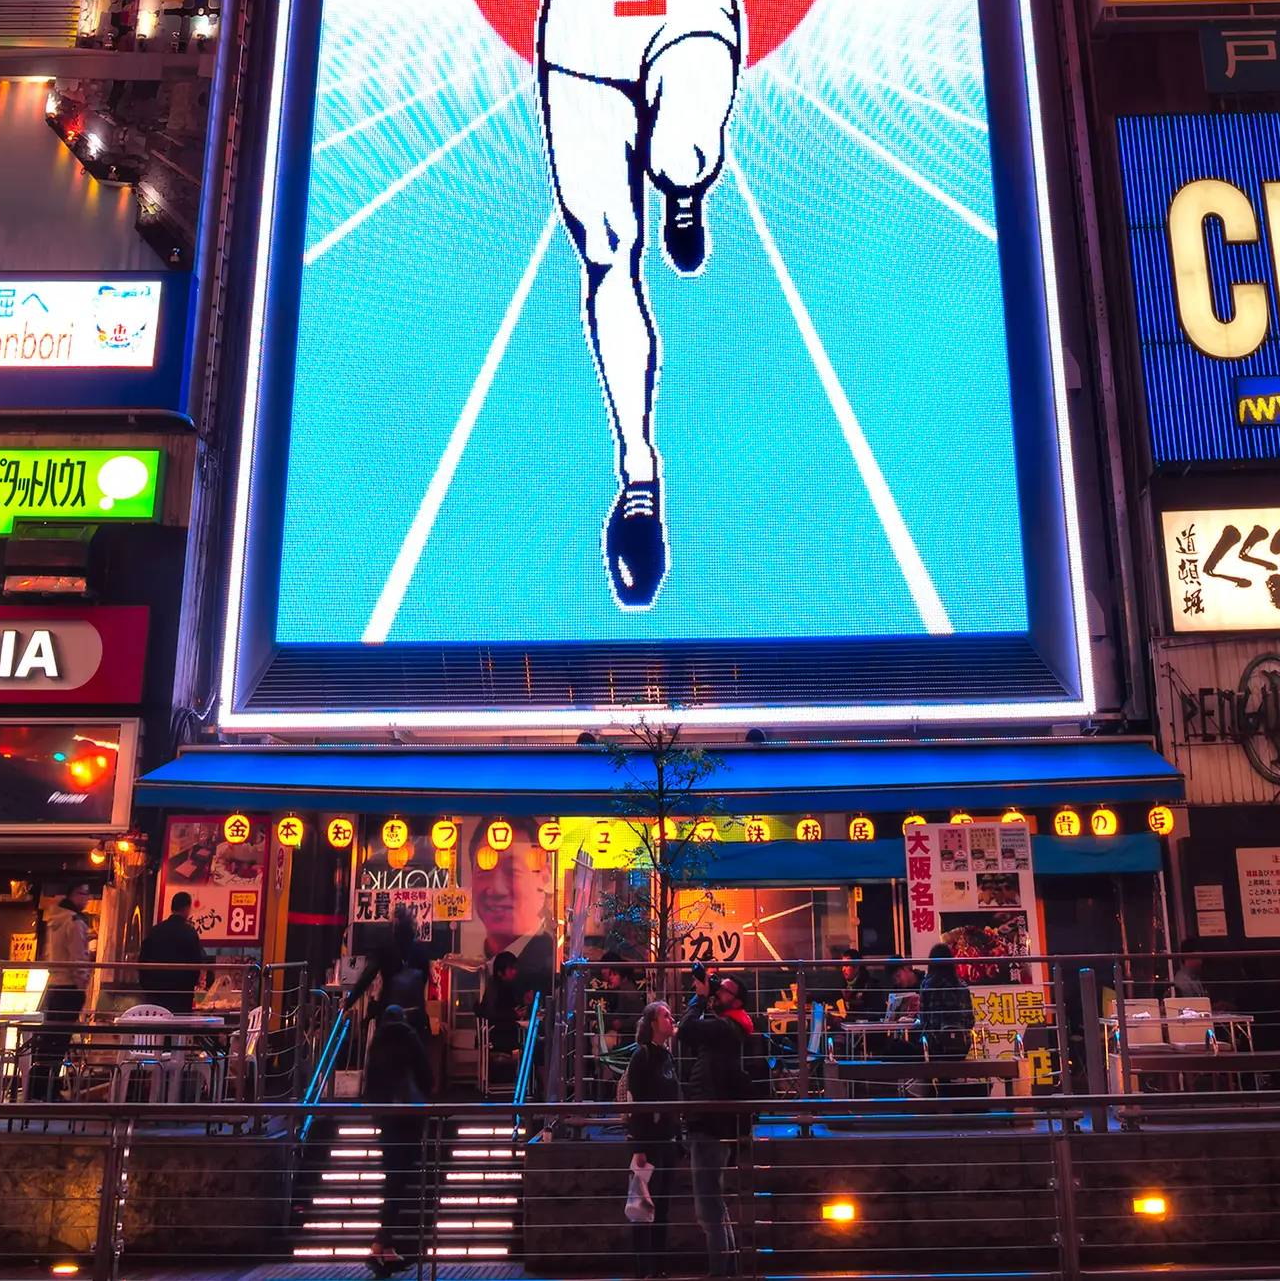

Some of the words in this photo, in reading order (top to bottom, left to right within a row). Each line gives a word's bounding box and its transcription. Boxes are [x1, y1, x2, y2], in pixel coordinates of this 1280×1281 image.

[1176, 524, 1205, 616] 道頓堀
[230, 907, 255, 933] 8F
[907, 830, 935, 933] 大阪名物
